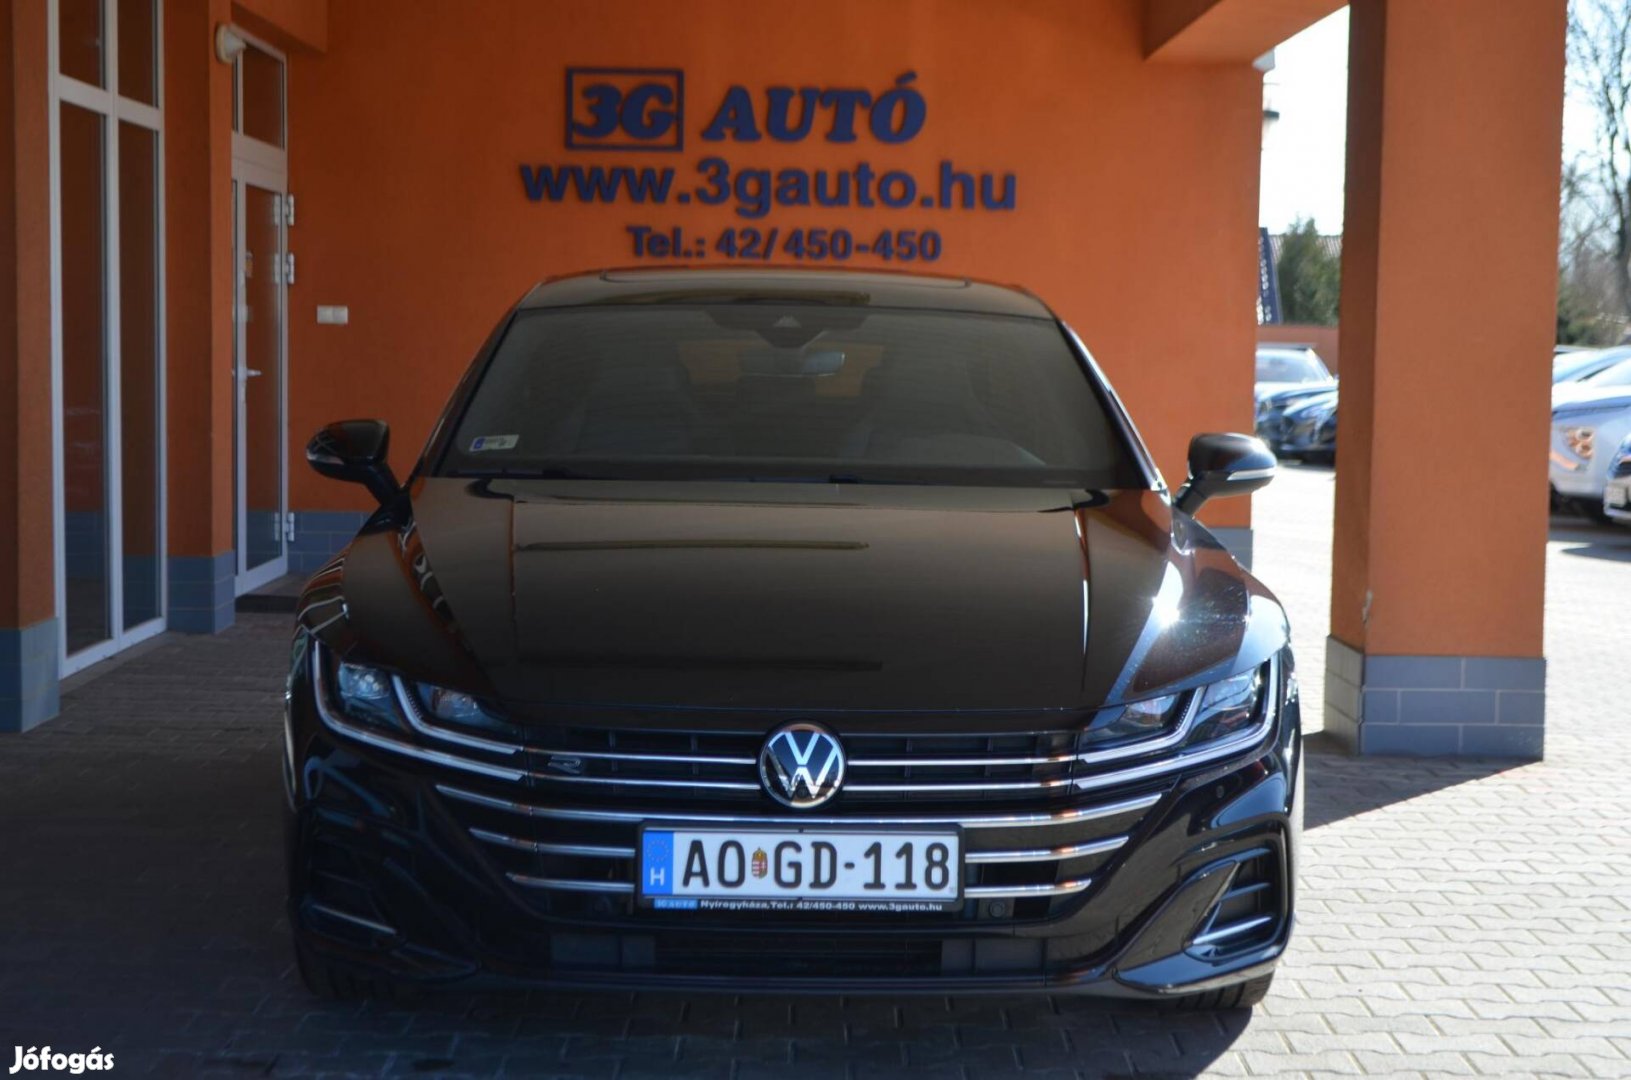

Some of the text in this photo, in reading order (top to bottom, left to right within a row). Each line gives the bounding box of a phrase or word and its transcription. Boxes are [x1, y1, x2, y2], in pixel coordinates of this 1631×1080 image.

[572, 71, 926, 143] 3G AUTÓ
[519, 157, 1016, 218] www.3gauto.hu
[627, 226, 706, 258] Tel.:
[650, 868, 665, 886] H
[774, 841, 950, 890] GD-118
